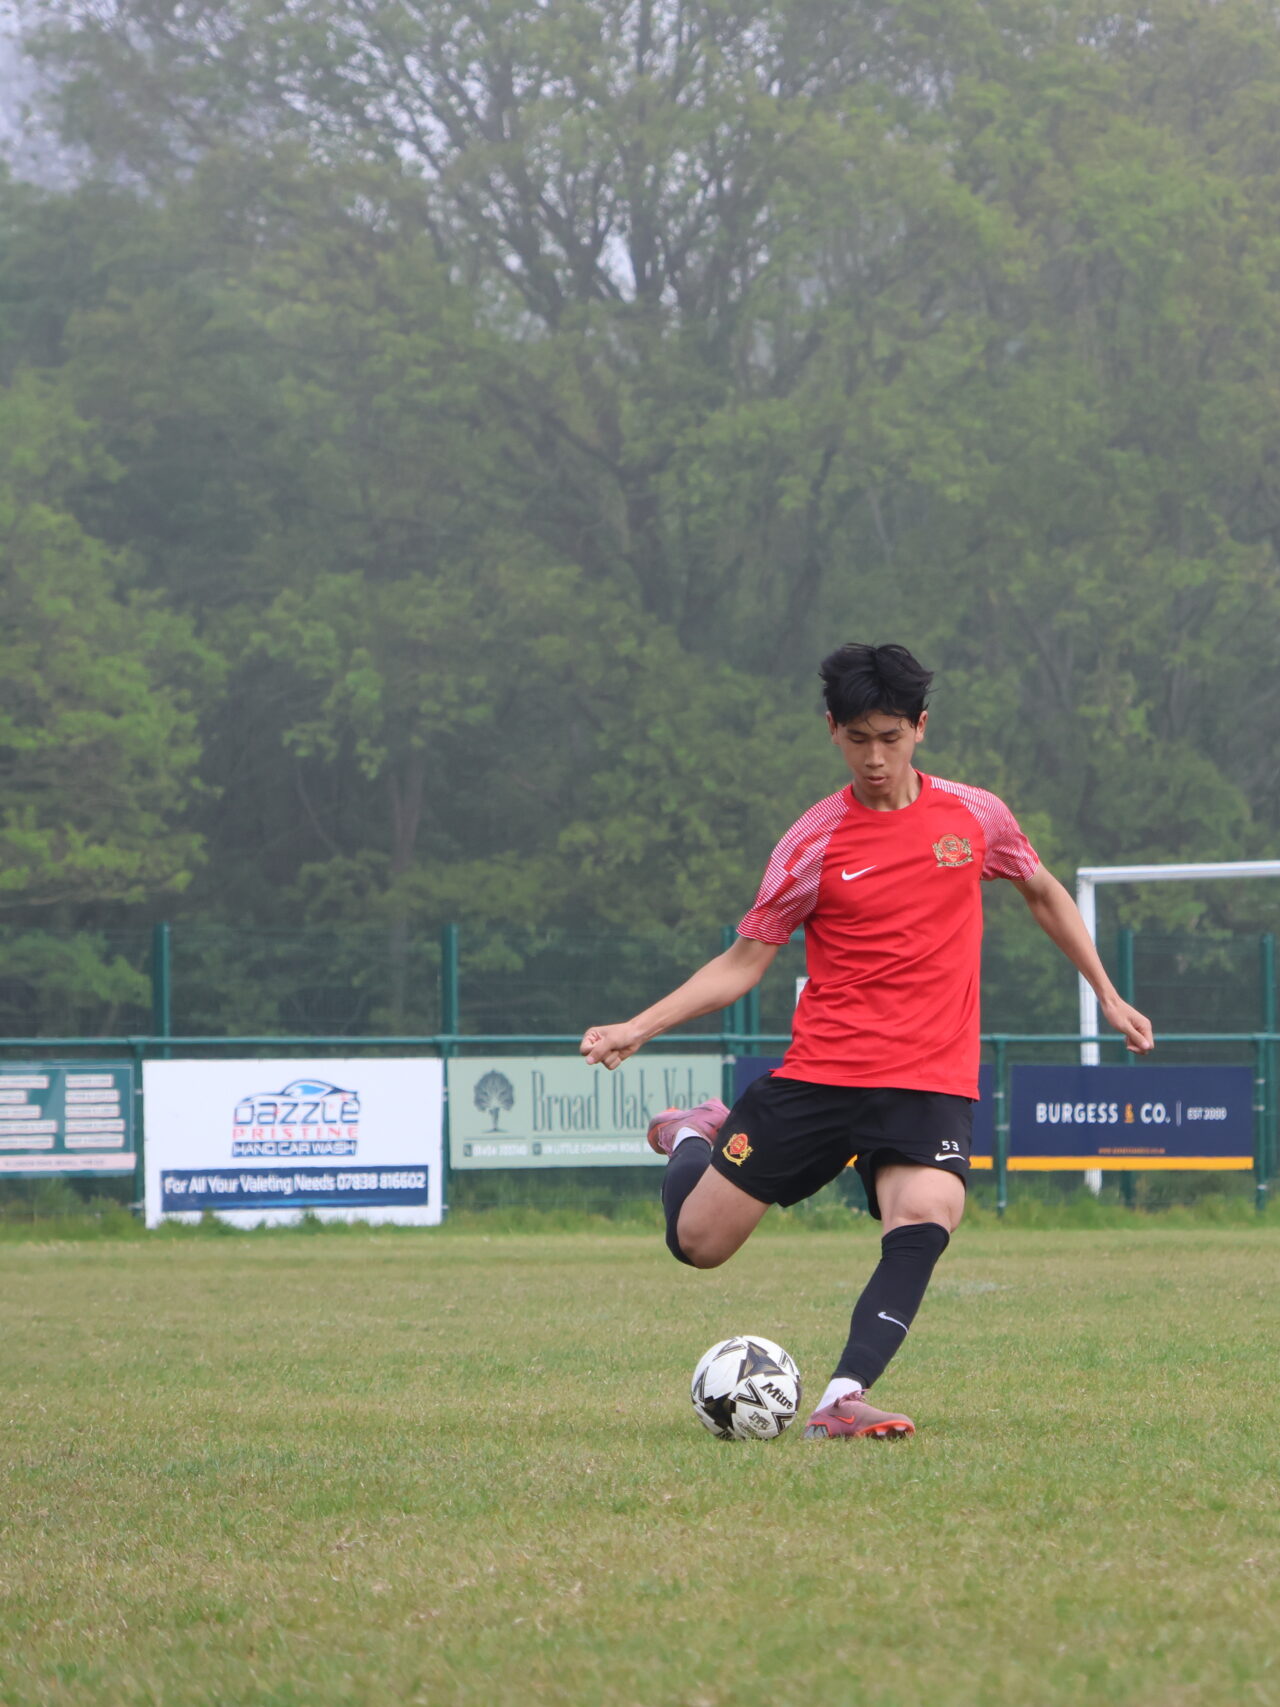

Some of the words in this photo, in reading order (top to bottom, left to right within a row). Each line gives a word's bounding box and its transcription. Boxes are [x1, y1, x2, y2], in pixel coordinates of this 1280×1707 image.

[531, 1069, 600, 1132] Broad
[612, 1068, 655, 1131] Oak
[1036, 1102, 1119, 1124] BURGESS
[1124, 1103, 1135, 1124] &
[1140, 1102, 1171, 1124] CO.
[232, 1126, 359, 1140] PRISTINE
[233, 1141, 277, 1156] HAND
[278, 1141, 311, 1155] CAR
[311, 1140, 355, 1155] WASH
[941, 1140, 960, 1152] 53
[164, 1175, 188, 1194] For
[188, 1175, 208, 1194] All
[207, 1174, 240, 1194] Your
[239, 1173, 294, 1195] Valeting
[293, 1172, 336, 1191] Needs
[760, 1382, 793, 1410] Mitre
